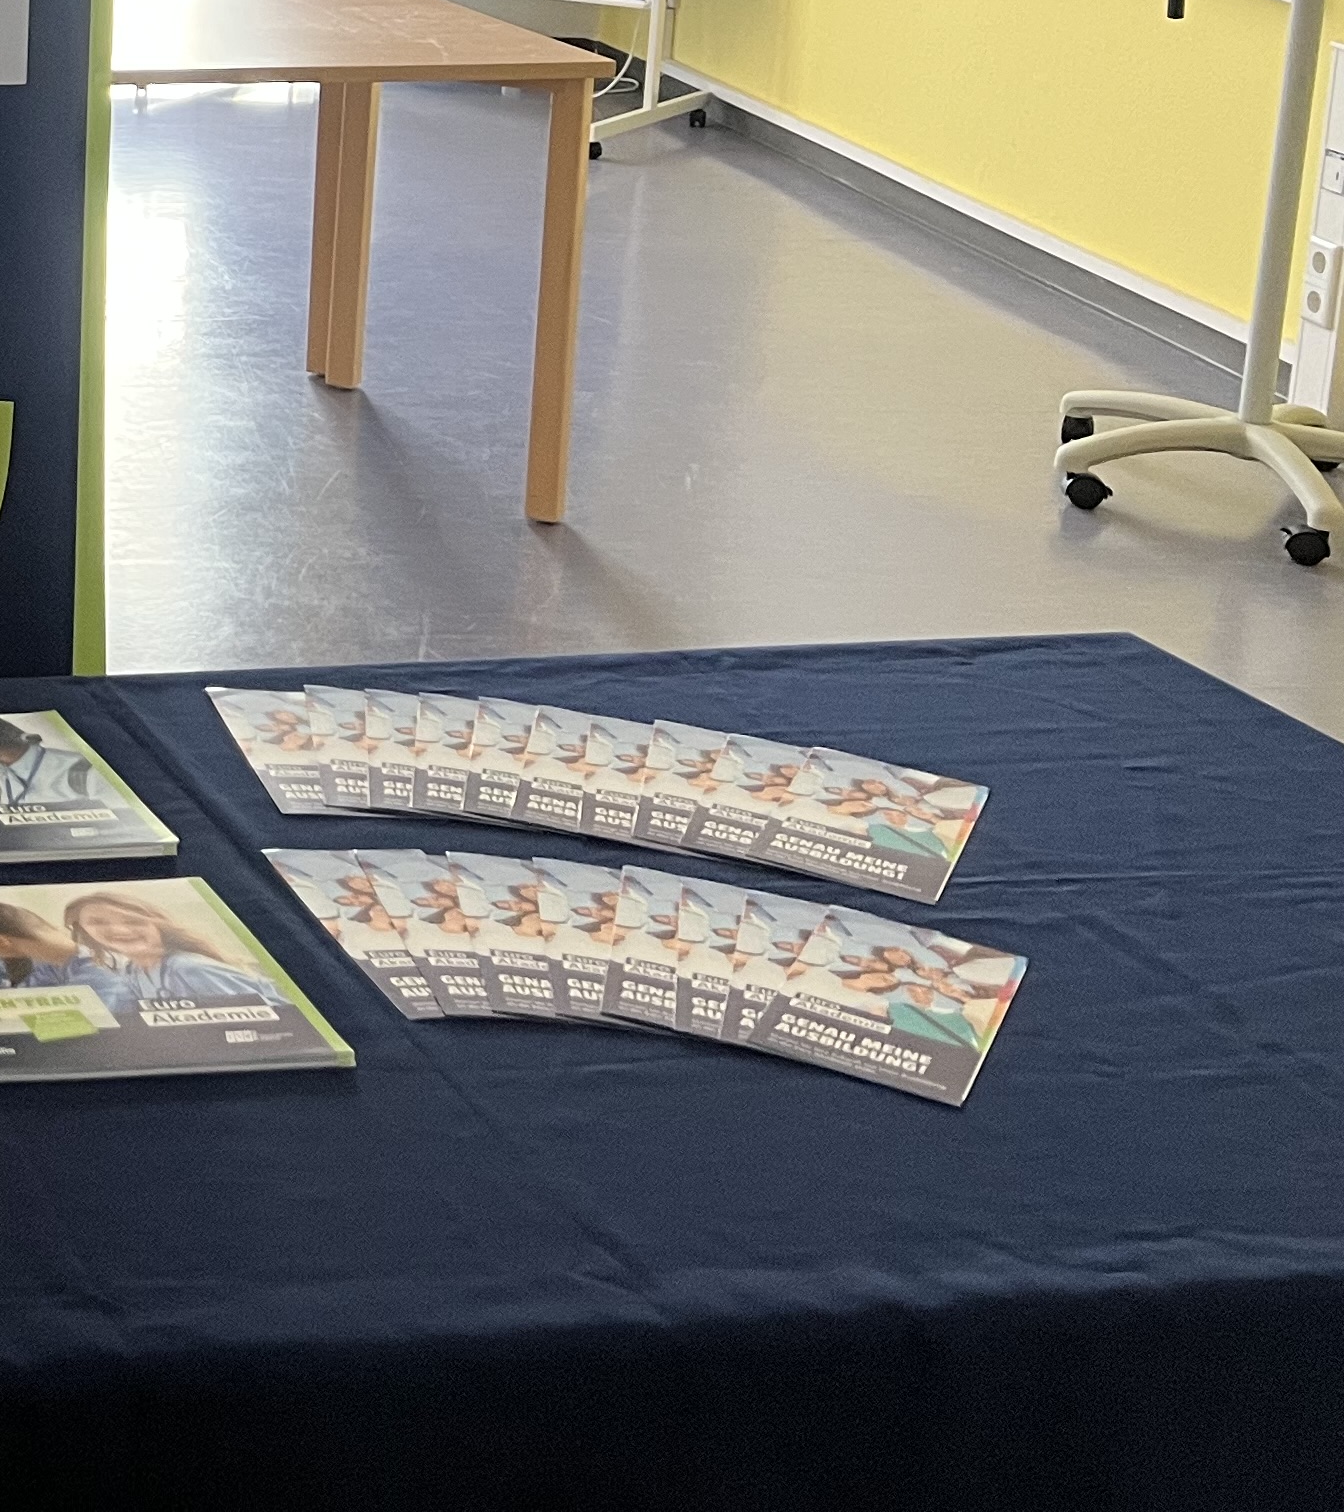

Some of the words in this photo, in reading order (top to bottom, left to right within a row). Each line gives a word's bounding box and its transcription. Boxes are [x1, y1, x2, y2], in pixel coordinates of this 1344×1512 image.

[8, 811, 112, 825] Akademie
[845, 850, 909, 874] MEINE
[138, 998, 197, 1011] Euro
[152, 1007, 272, 1026] Akademie
[781, 1012, 857, 1042] GENAU
[861, 1036, 933, 1065] MEINE
